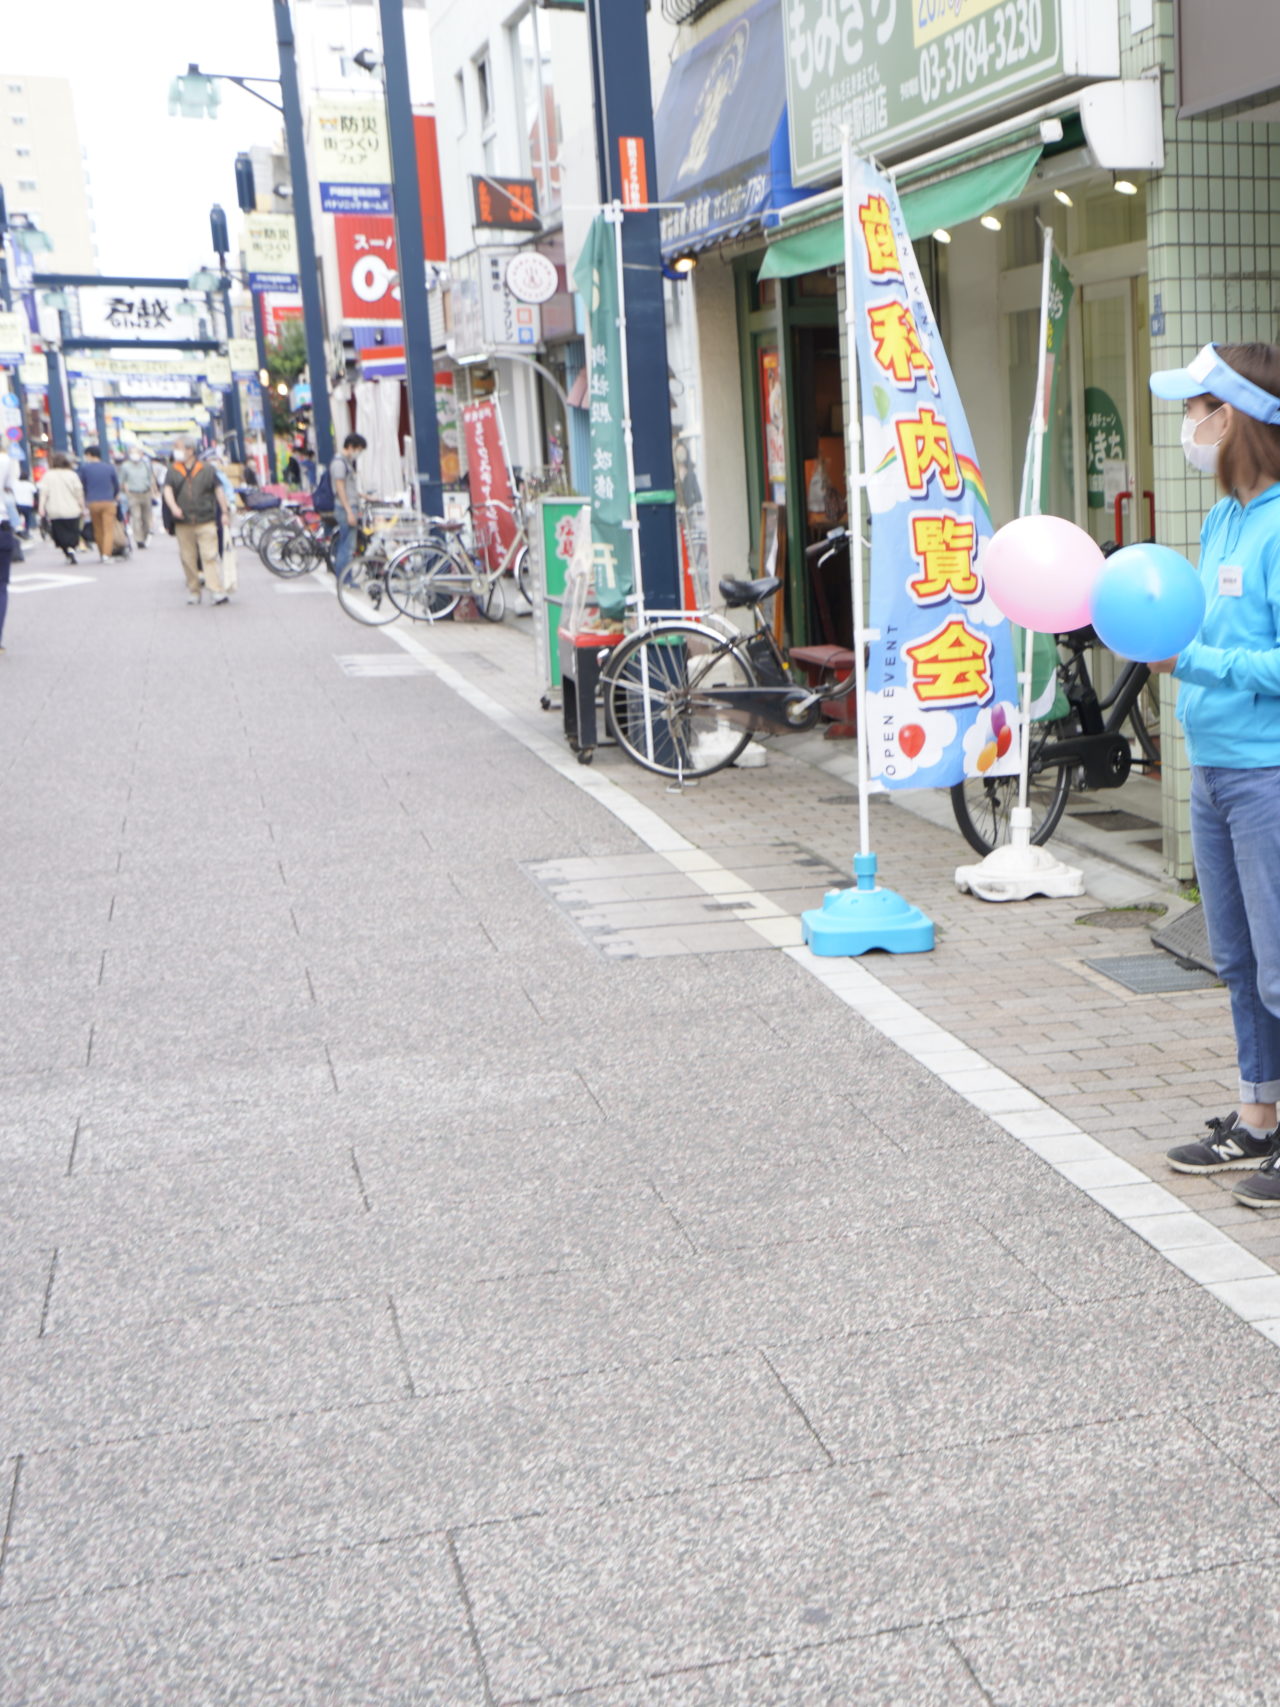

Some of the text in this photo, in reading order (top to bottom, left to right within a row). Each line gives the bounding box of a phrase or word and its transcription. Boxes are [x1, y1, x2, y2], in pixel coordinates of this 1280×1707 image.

[919, 0, 1042, 104] 03-3784-3230
[340, 114, 378, 134] 防災
[860, 193, 991, 702] 歯科内覧会
[883, 624, 898, 776] OPEN EVENT
